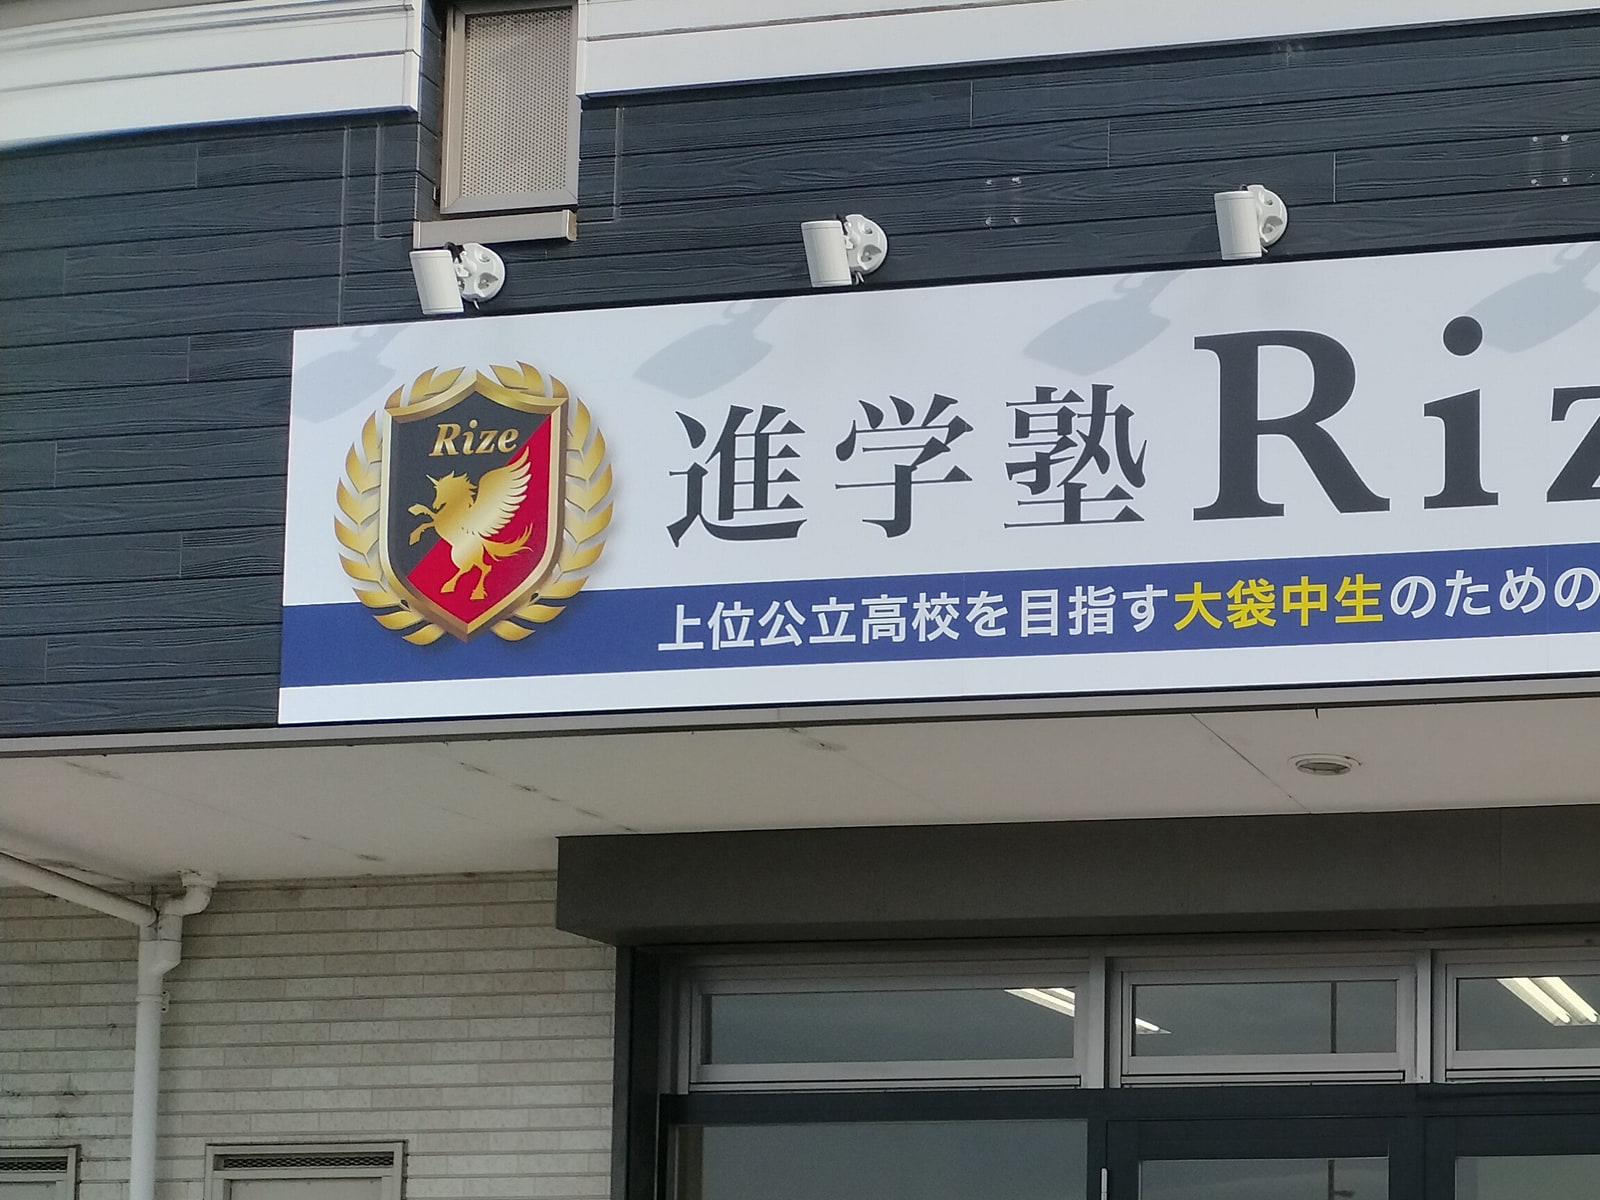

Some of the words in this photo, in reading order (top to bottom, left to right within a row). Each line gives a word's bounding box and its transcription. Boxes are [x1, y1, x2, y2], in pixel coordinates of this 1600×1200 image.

[428, 419, 519, 457] Rize
[667, 384, 1146, 547] 進学塾
